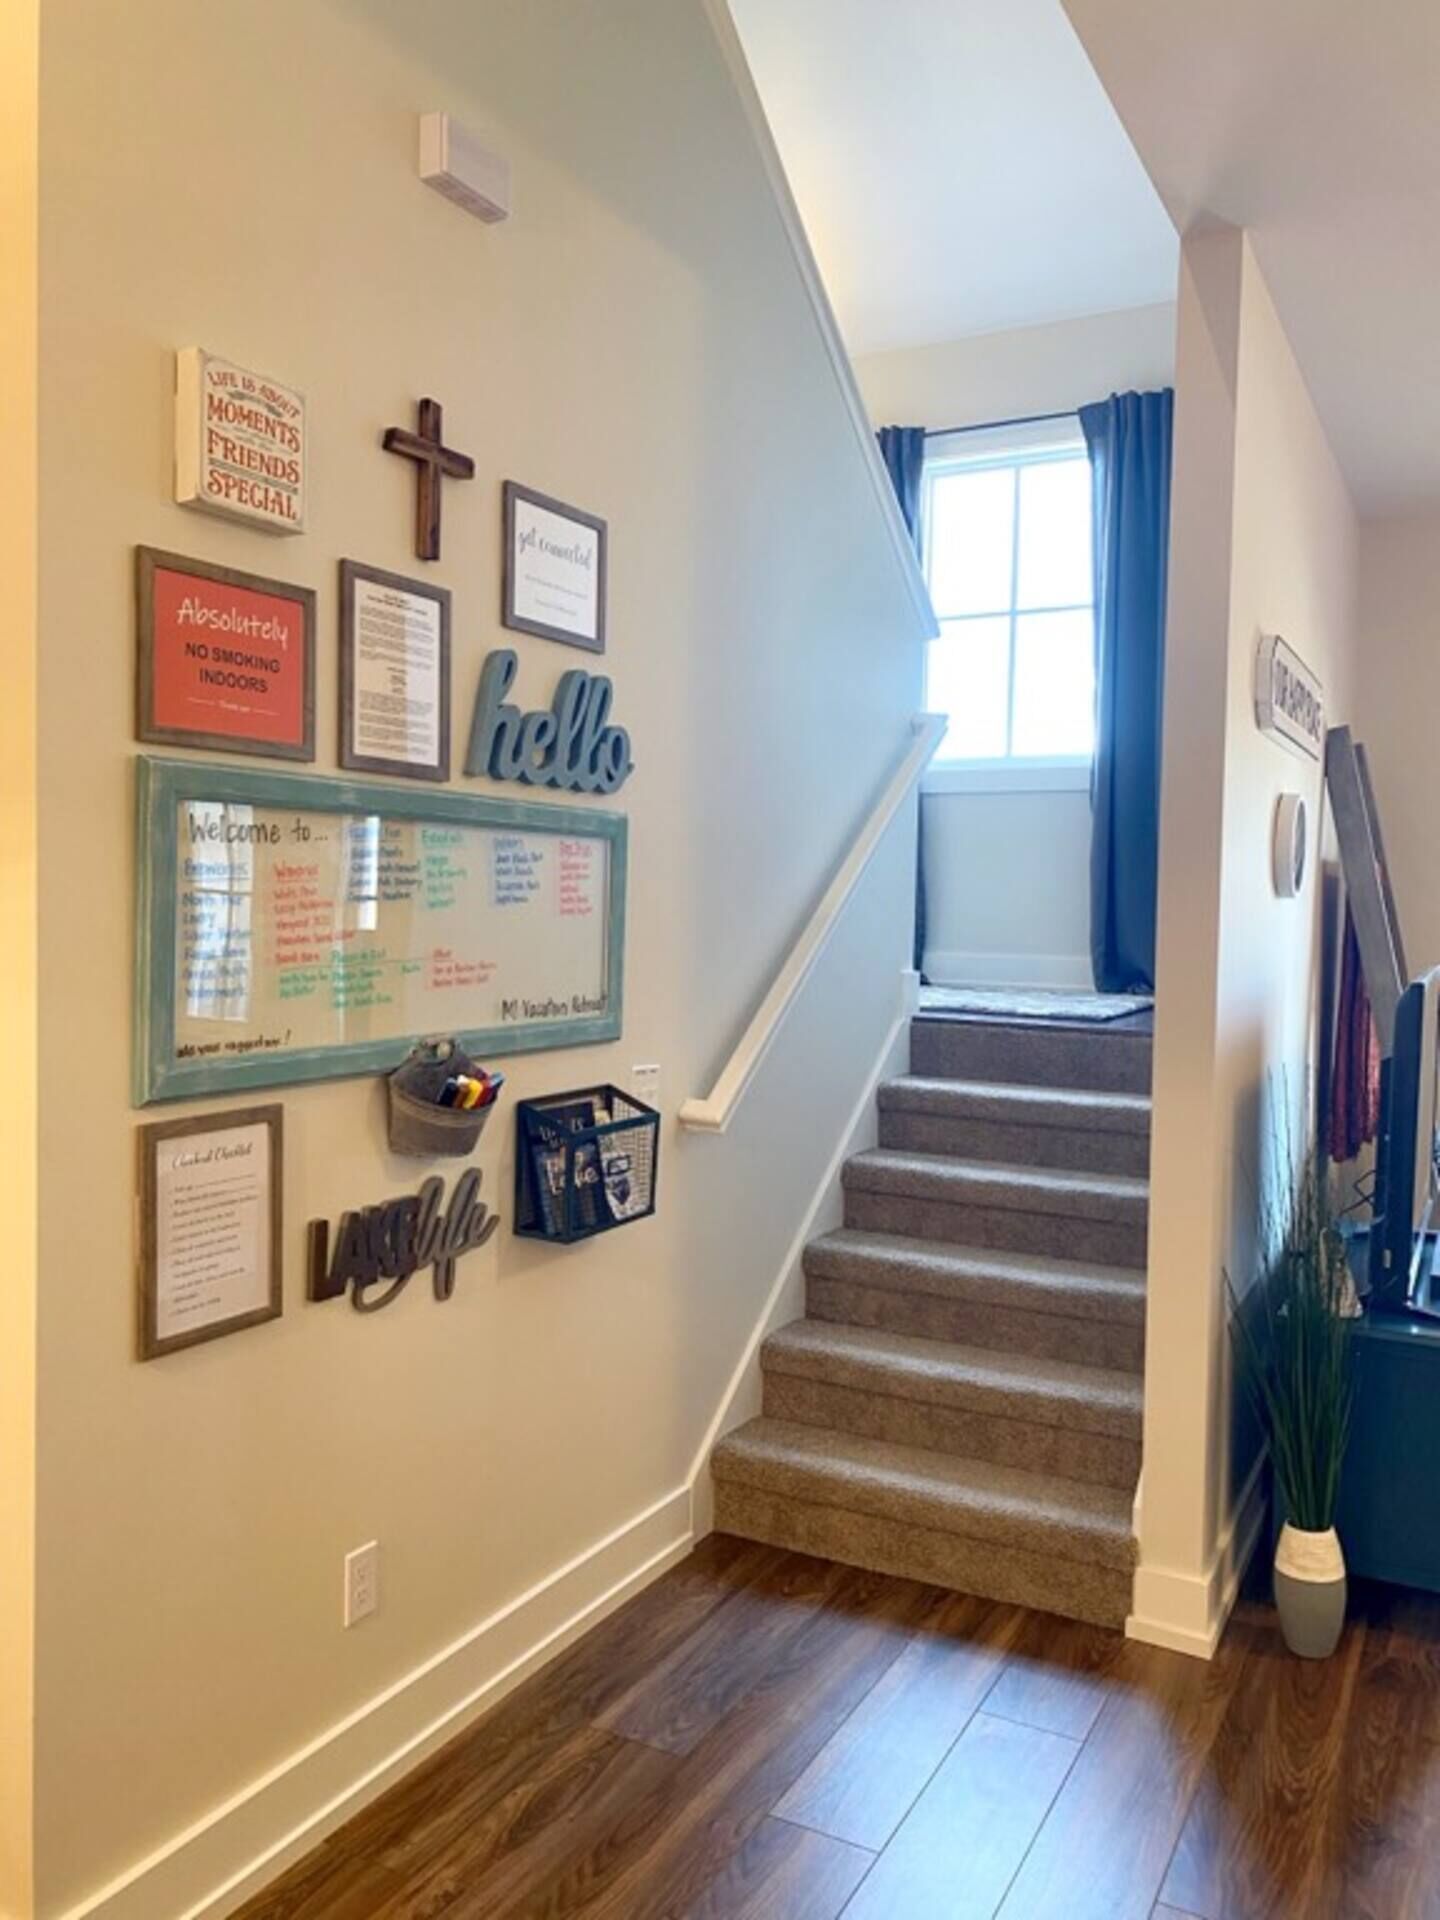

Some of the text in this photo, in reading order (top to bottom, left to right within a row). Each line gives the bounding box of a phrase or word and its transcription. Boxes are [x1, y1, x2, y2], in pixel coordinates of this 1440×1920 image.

[208, 371, 238, 388] LIFE
[242, 377, 256, 393] IS
[207, 393, 301, 453] MOMENTS
[207, 427, 300, 484] FRIENDS
[207, 469, 297, 520] SPECIAL
[177, 597, 289, 649] Absolutely
[185, 642, 280, 674] NO SMOKING
[199, 668, 269, 693] INDOORS
[463, 649, 634, 795] hello
[189, 813, 281, 843] Welcome
